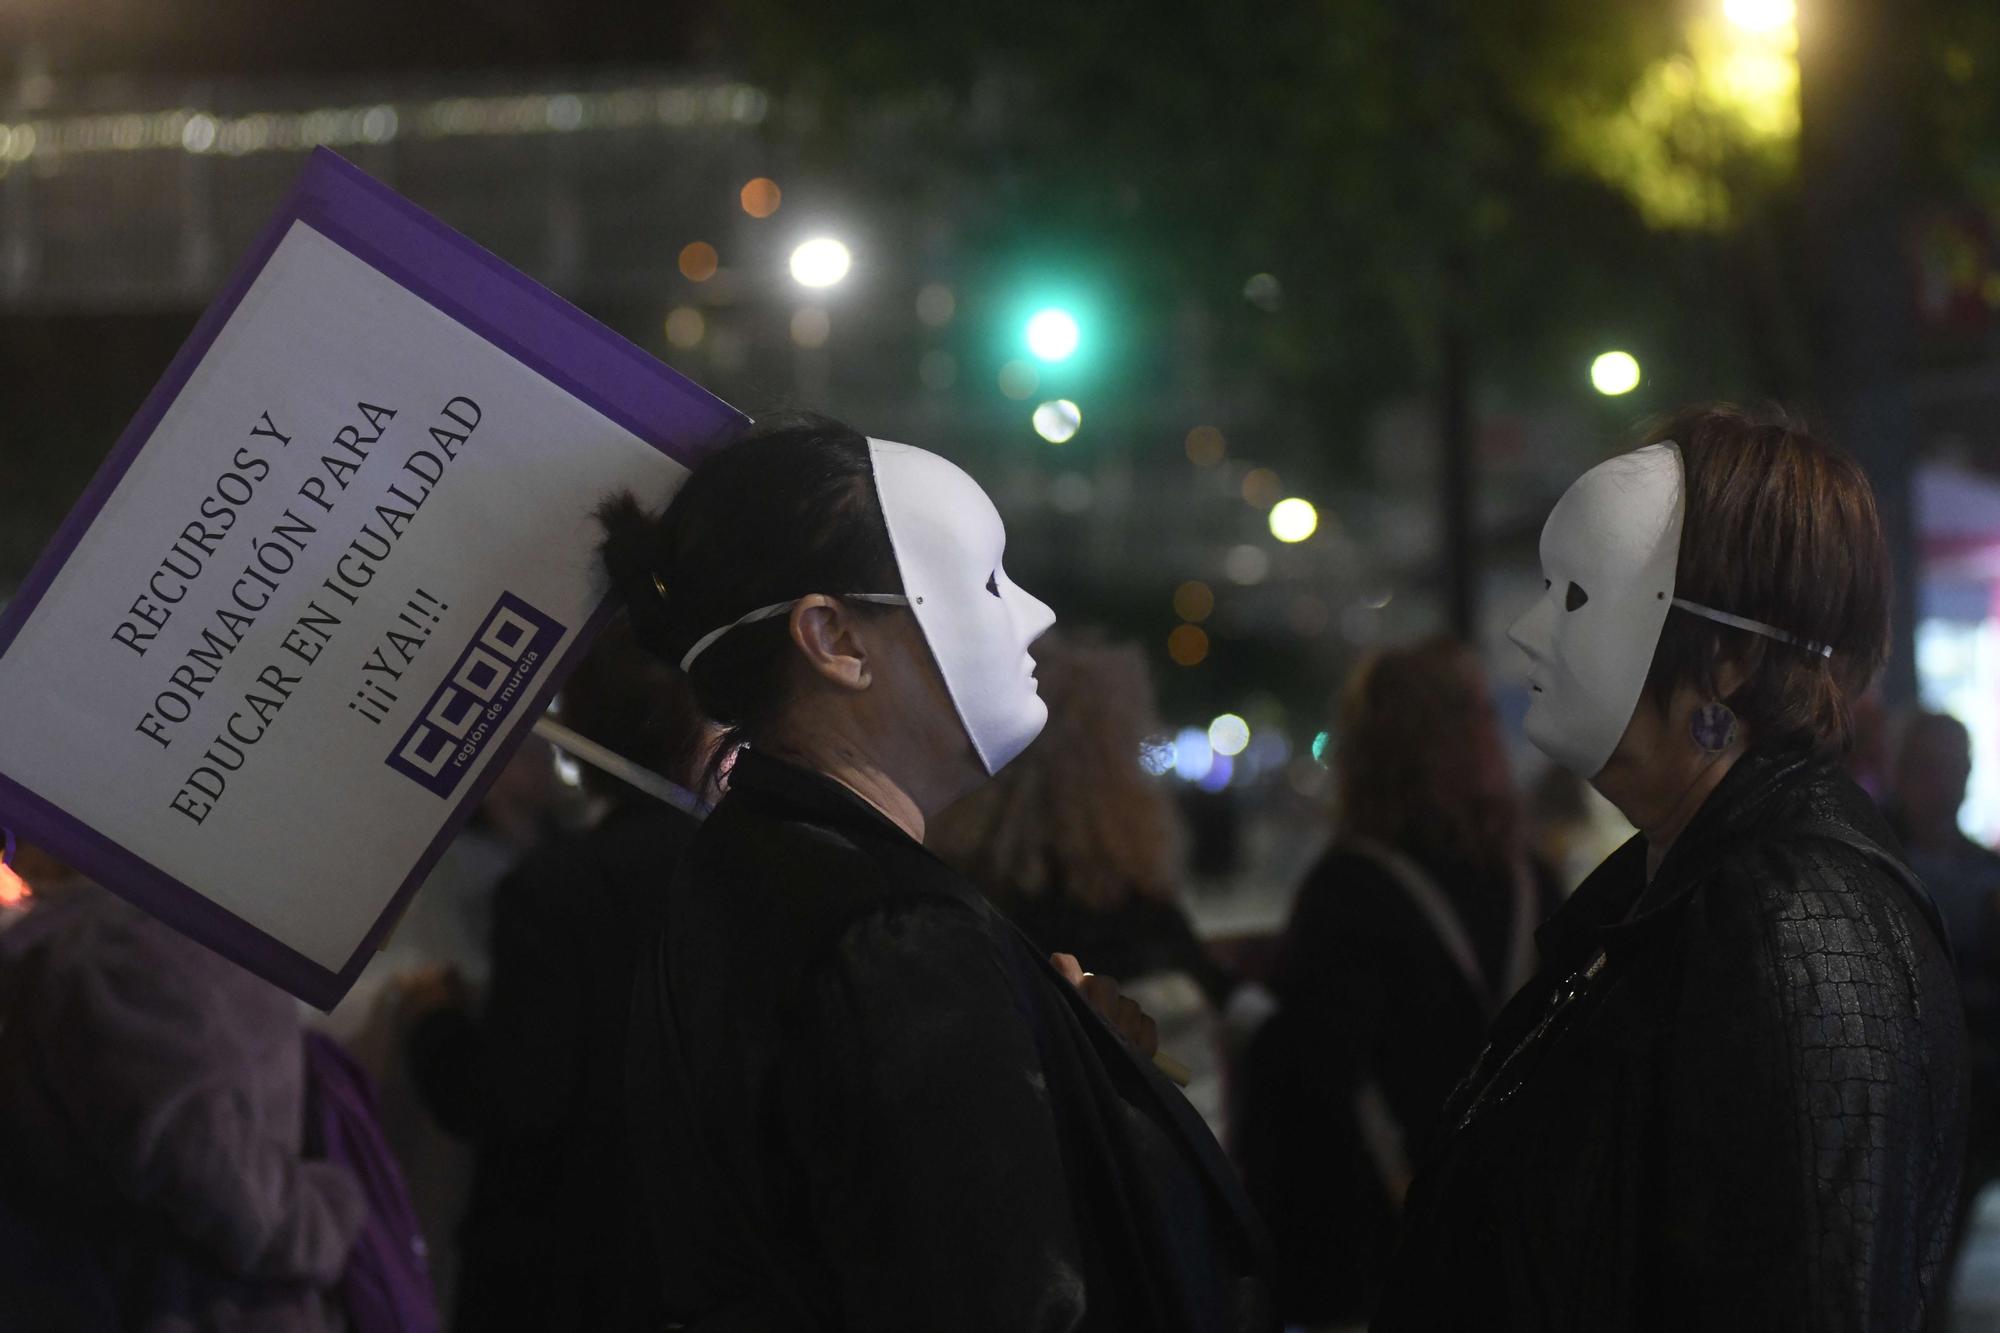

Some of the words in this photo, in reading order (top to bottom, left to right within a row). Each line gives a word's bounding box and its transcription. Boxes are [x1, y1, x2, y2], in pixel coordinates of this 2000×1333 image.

[111, 447, 271, 657] RECURSOS
[251, 411, 291, 448] Y
[135, 509, 316, 748] FORMACIÓN
[298, 401, 397, 513] PARA
[169, 665, 302, 825] EDUCAR
[281, 600, 341, 666] EN
[324, 396, 482, 605] IGUALDAD
[349, 589, 448, 724] ¡¡¡YA!!!
[400, 606, 540, 778] CCOO
[453, 722, 488, 767] región
[487, 702, 503, 721] de
[500, 650, 539, 702] murcia
